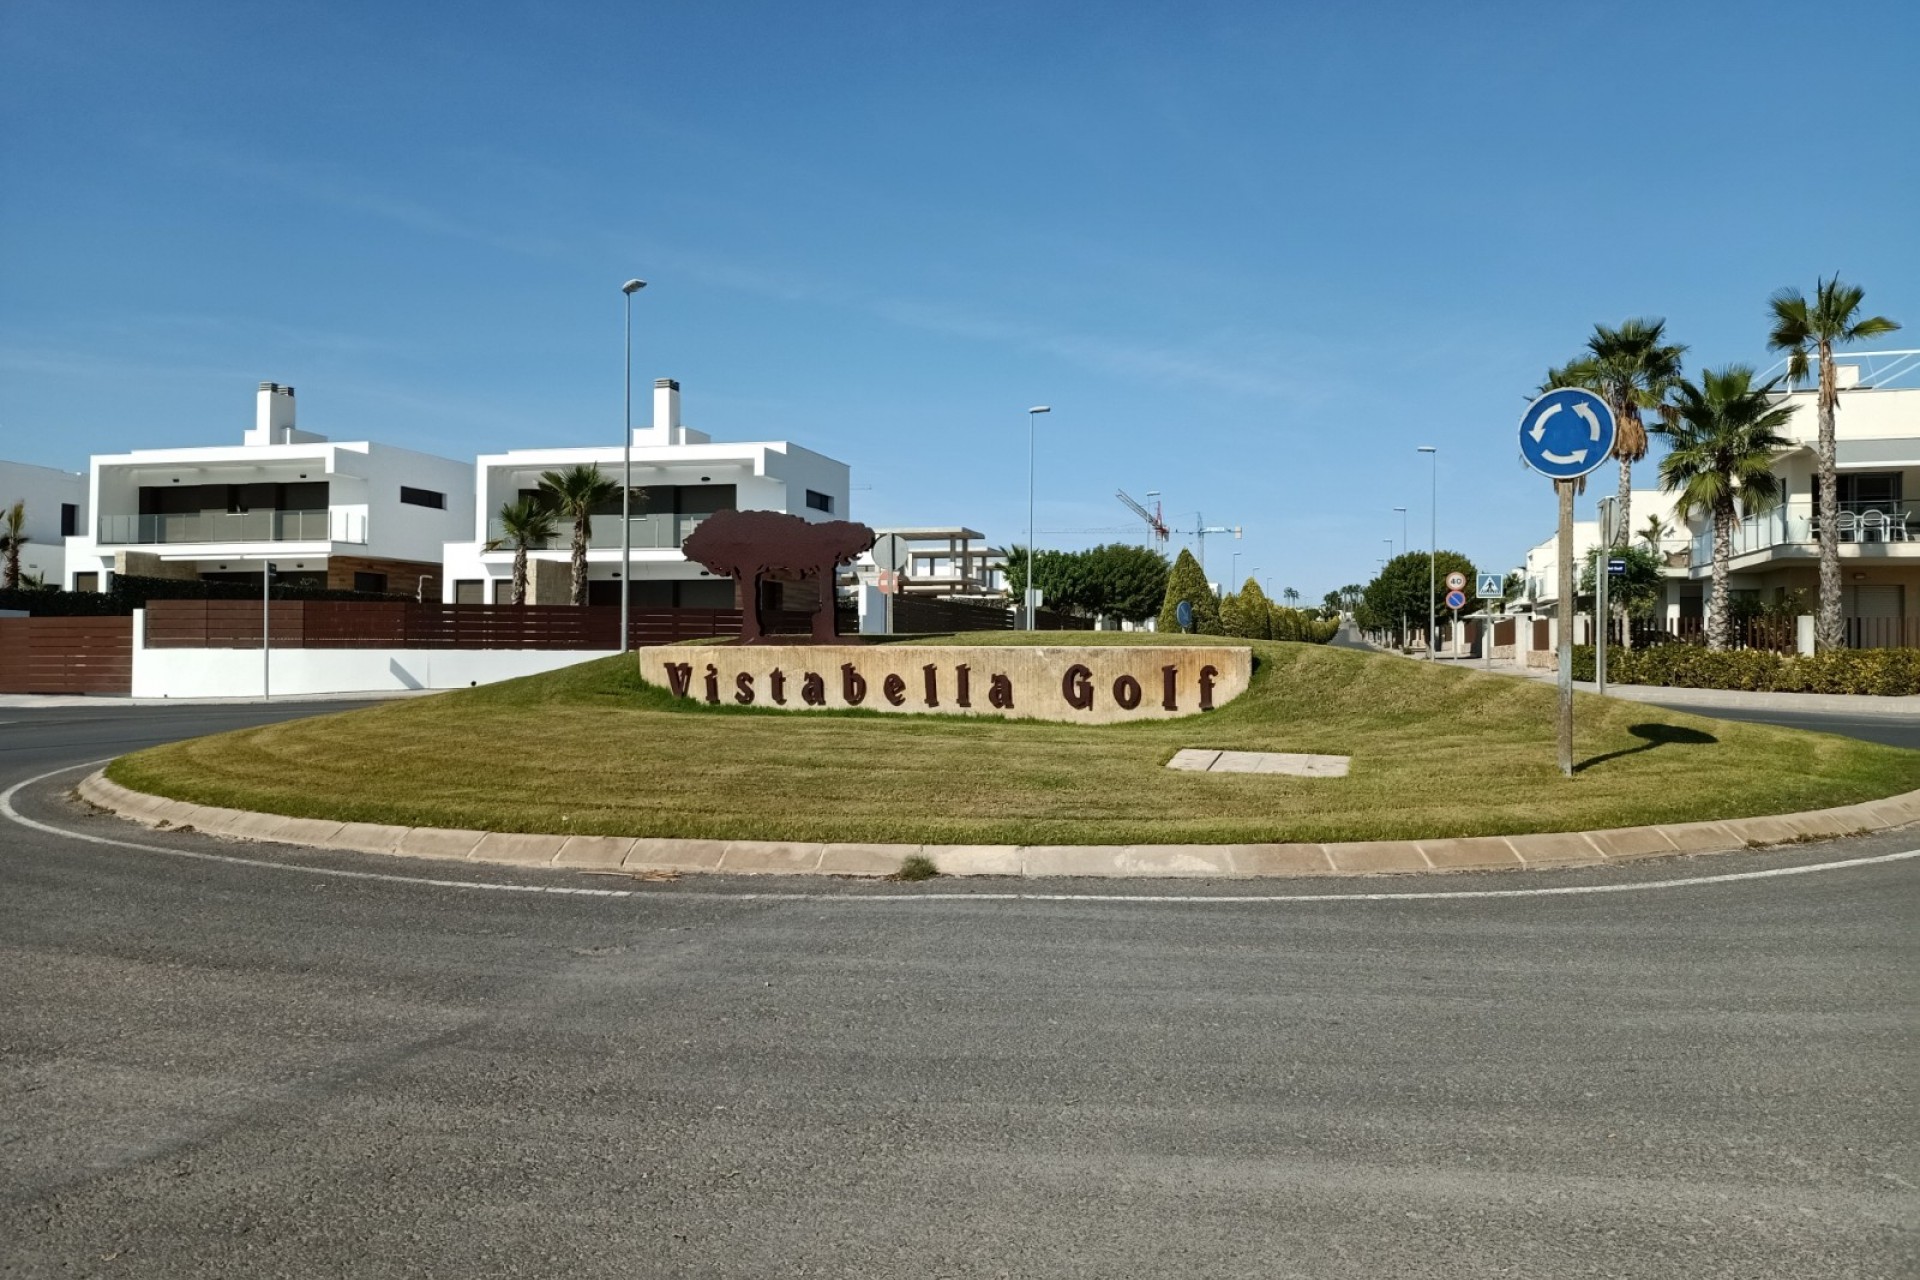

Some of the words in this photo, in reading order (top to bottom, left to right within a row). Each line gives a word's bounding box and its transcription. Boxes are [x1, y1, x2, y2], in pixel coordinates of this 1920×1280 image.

[1450, 577, 1462, 585] 40
[663, 662, 1014, 710] Vistabella
[1062, 663, 1219, 712] Golf
